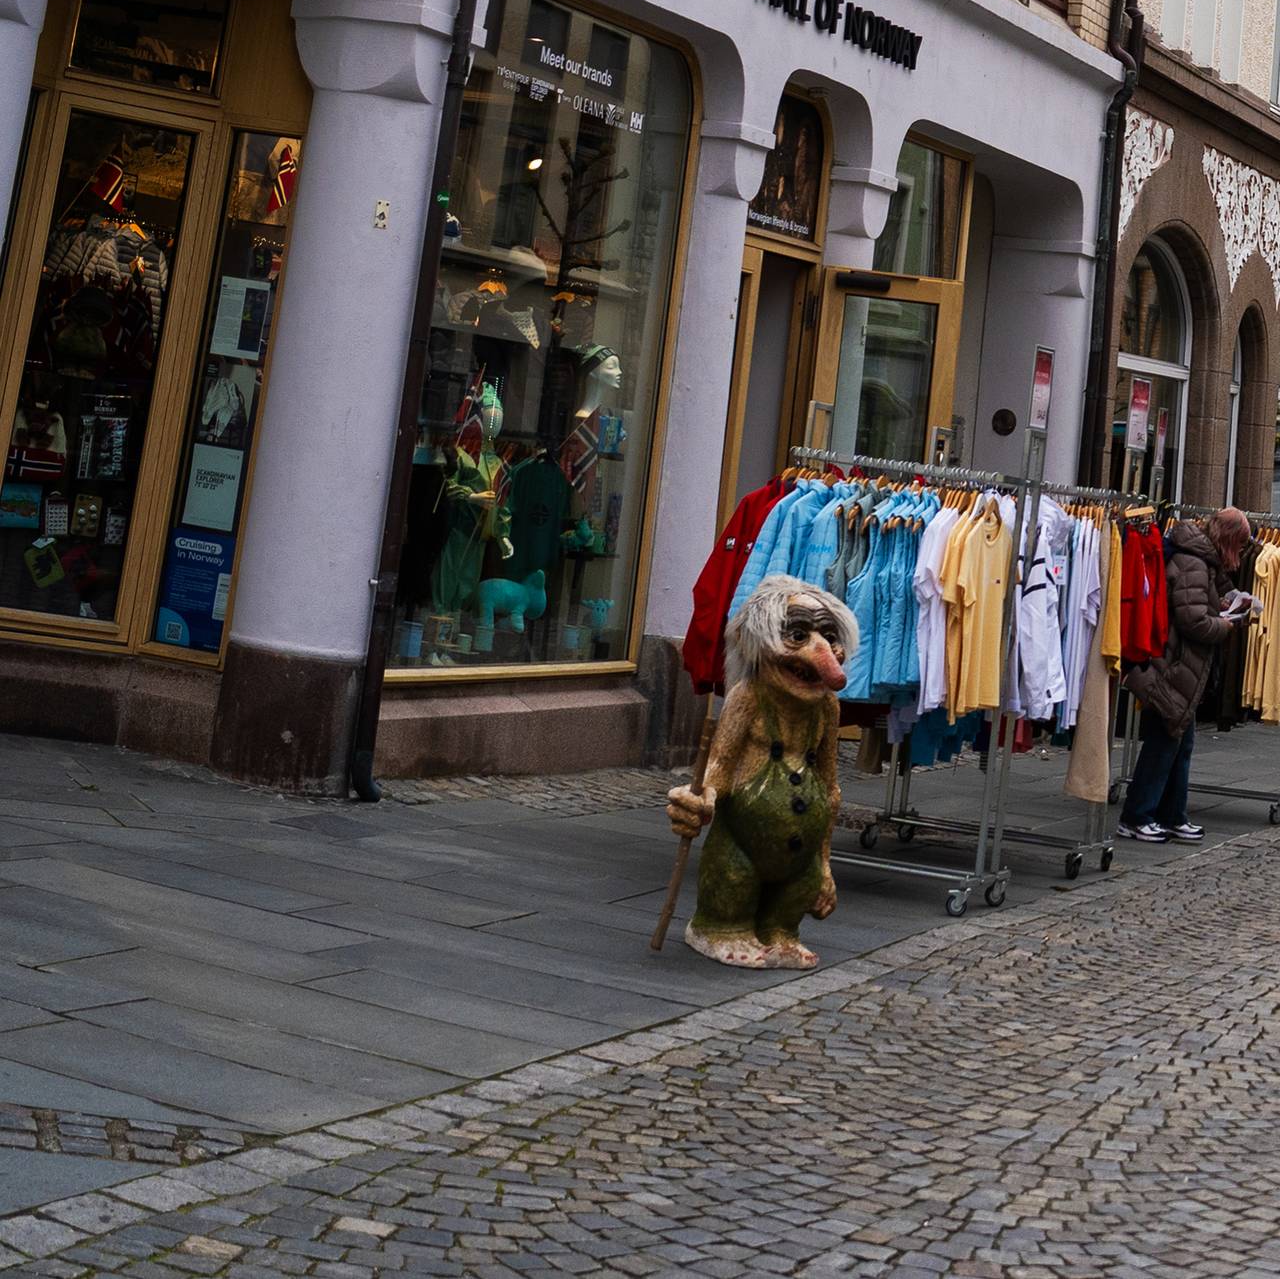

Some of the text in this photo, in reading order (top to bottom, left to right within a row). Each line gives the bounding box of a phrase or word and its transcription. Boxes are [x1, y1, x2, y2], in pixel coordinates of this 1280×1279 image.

[844, 2, 923, 70] NORWAY
[540, 45, 612, 87] Meet our brands
[573, 95, 604, 119] OLEANA
[179, 537, 218, 554] Cruising
[177, 549, 225, 567] in Norway
